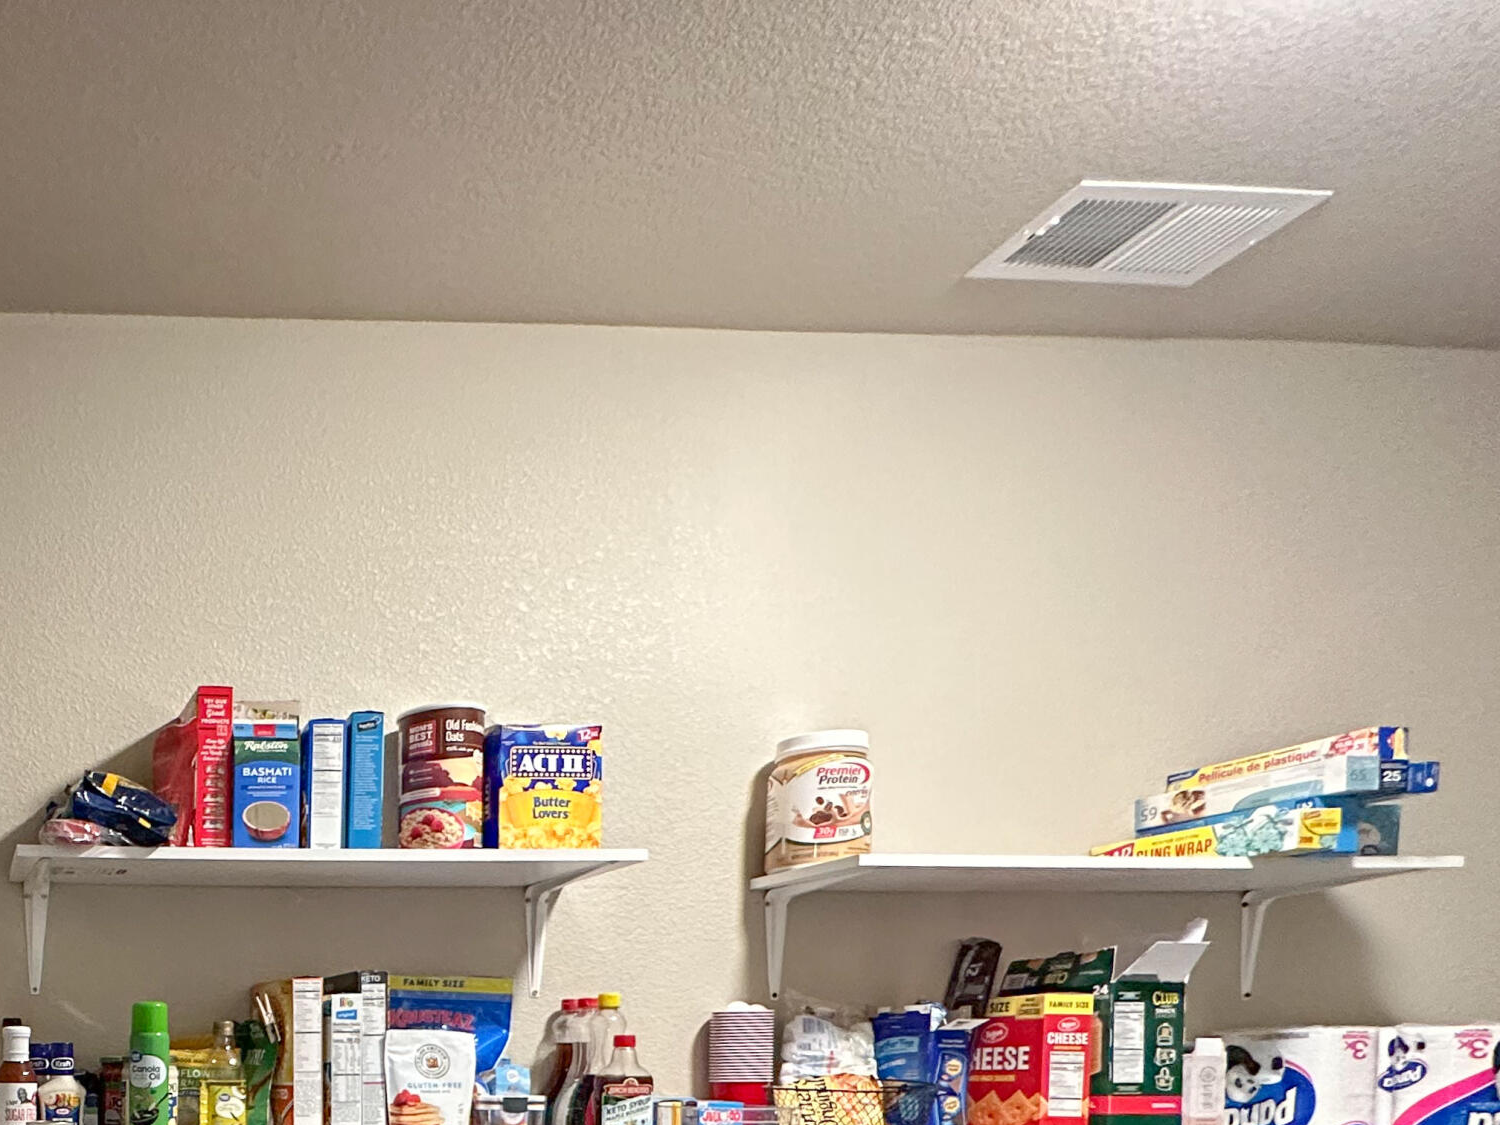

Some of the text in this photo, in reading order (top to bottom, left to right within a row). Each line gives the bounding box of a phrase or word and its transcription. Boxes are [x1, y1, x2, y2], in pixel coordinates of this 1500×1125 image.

[445, 718, 460, 731] Old
[409, 731, 433, 744] BEST
[445, 731, 465, 742] Oats
[518, 754, 585, 773] ACT II
[1198, 766, 1243, 784] Pellicule
[1246, 760, 1260, 772] de
[1263, 748, 1318, 771] plastique
[242, 767, 292, 777] BASMATI
[816, 765, 863, 777] Premier
[1383, 769, 1402, 782] 25
[257, 776, 277, 784] RICE
[818, 774, 859, 785] Protein
[532, 796, 572, 808] Butter
[532, 808, 569, 819] Lovers
[1175, 838, 1213, 857] WRAP
[403, 978, 465, 988] FAMILY SIZE
[1092, 984, 1109, 996] 24
[990, 1001, 1011, 1014] SIZE
[1046, 1031, 1089, 1045] CHEESE
[973, 1045, 1031, 1071] HEESE
[131, 1064, 161, 1075] Canola
[148, 1071, 161, 1082] Oil
[442, 1082, 462, 1090] FREE
[606, 1103, 627, 1115] KETO
